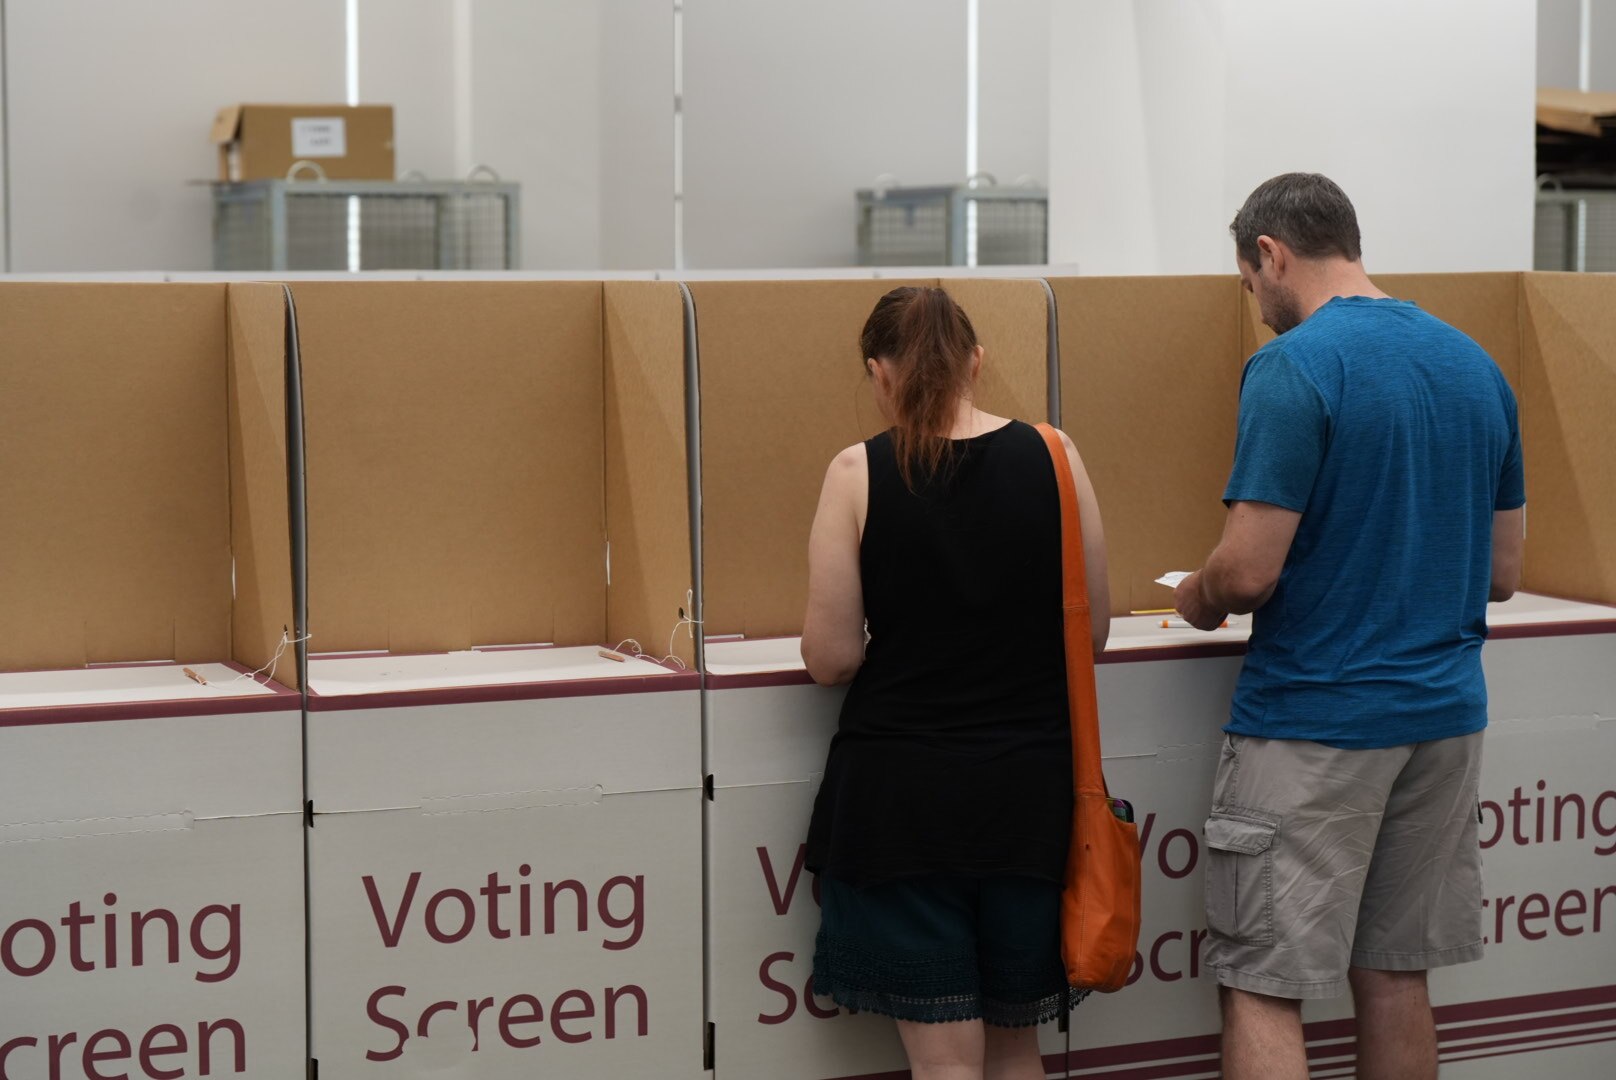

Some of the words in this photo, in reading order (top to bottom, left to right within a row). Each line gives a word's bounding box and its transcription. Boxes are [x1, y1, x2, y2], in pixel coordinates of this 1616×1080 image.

[360, 863, 645, 951] Voting
[756, 842, 822, 916] V
[1482, 884, 1616, 945] reen
[0, 893, 241, 984] oting
[1124, 928, 1208, 987] cr
[757, 950, 859, 1025] Sc
[0, 1018, 246, 1080] creen
